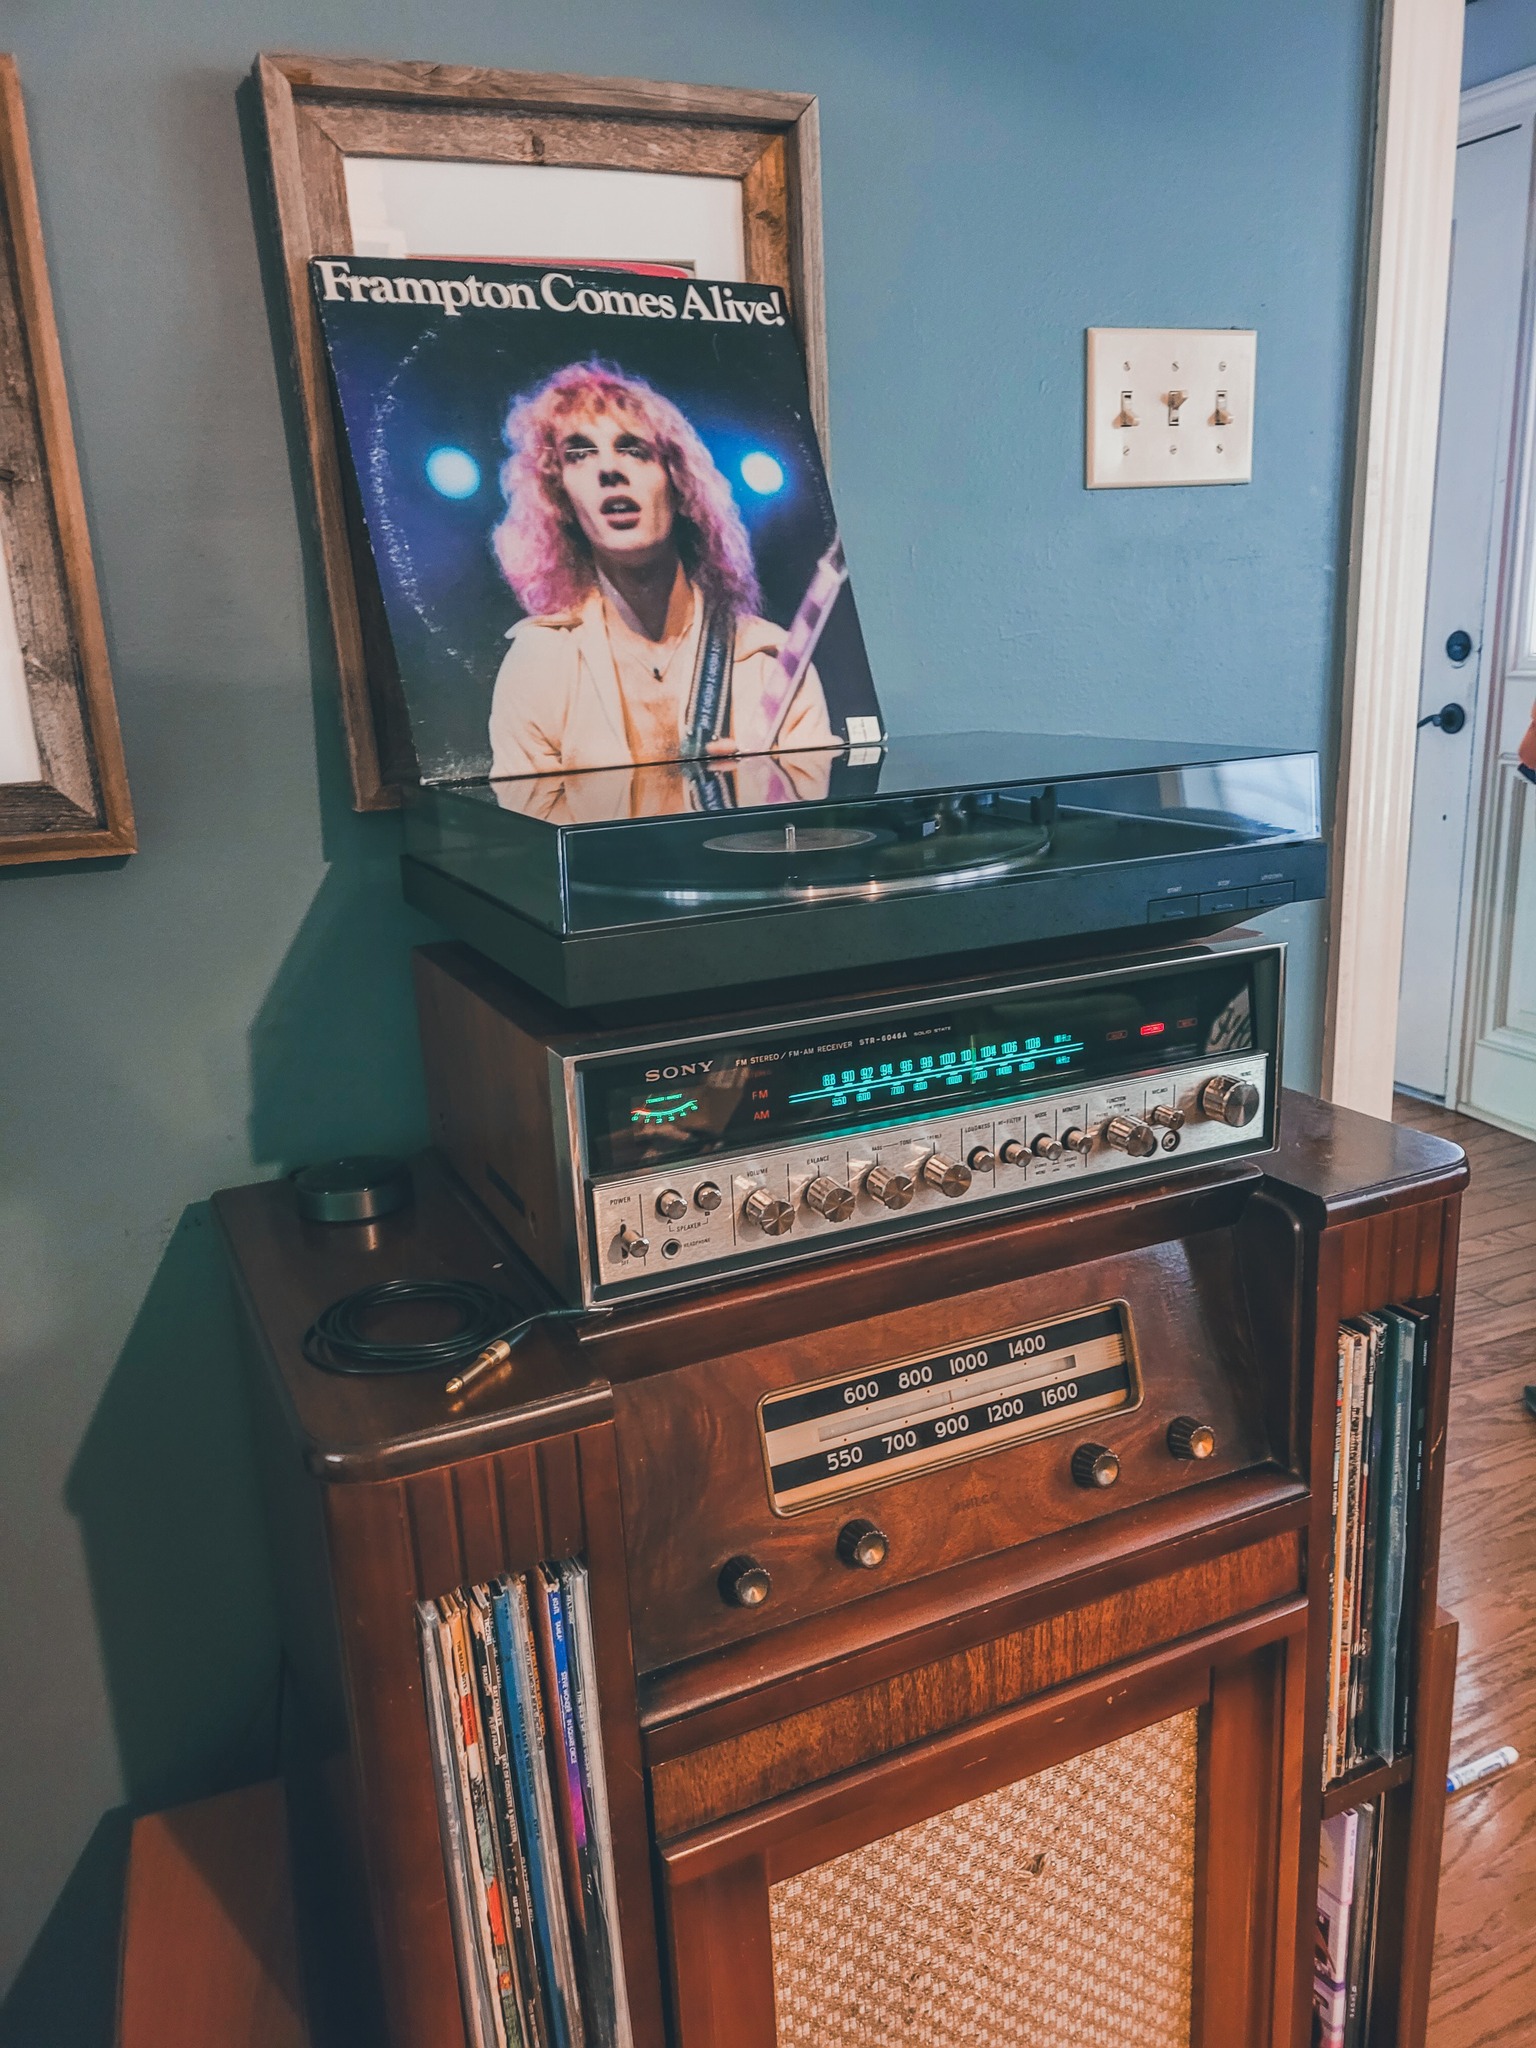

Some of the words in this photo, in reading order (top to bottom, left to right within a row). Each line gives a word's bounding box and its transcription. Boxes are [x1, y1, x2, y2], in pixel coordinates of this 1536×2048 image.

[314, 260, 540, 316] Frampton
[540, 272, 677, 319] Comes
[681, 286, 786, 325] Alive!
[735, 1059, 748, 1067] FM
[750, 1053, 780, 1065] STEREO
[788, 1048, 814, 1058] FM-AM
[817, 1041, 853, 1053] RECEIVER
[841, 1070, 855, 1083] 90
[860, 1066, 874, 1080] 92
[880, 1063, 893, 1076] 94
[900, 1059, 913, 1073] 96
[920, 1056, 933, 1069] 98
[939, 1052, 956, 1066] 100
[960, 1049, 974, 1062] 10
[980, 1045, 997, 1058] 104
[1001, 1041, 1018, 1054] 106
[1025, 1037, 1041, 1050] 108
[645, 1060, 714, 1082] SONY
[752, 1090, 768, 1100] FM
[753, 1110, 770, 1120] AM
[964, 1122, 991, 1133] LOUDNESS
[609, 1196, 631, 1206] POWER
[676, 1222, 702, 1233] SPEAKER
[843, 1380, 879, 1405] 600
[898, 1365, 933, 1390] 800
[949, 1350, 989, 1375] 1000
[1008, 1334, 1046, 1359] 1400
[827, 1447, 863, 1472] 550
[881, 1430, 917, 1455] 700
[934, 1414, 969, 1439] 900
[987, 1398, 1024, 1423] 1200
[1041, 1382, 1078, 1407] 1600
